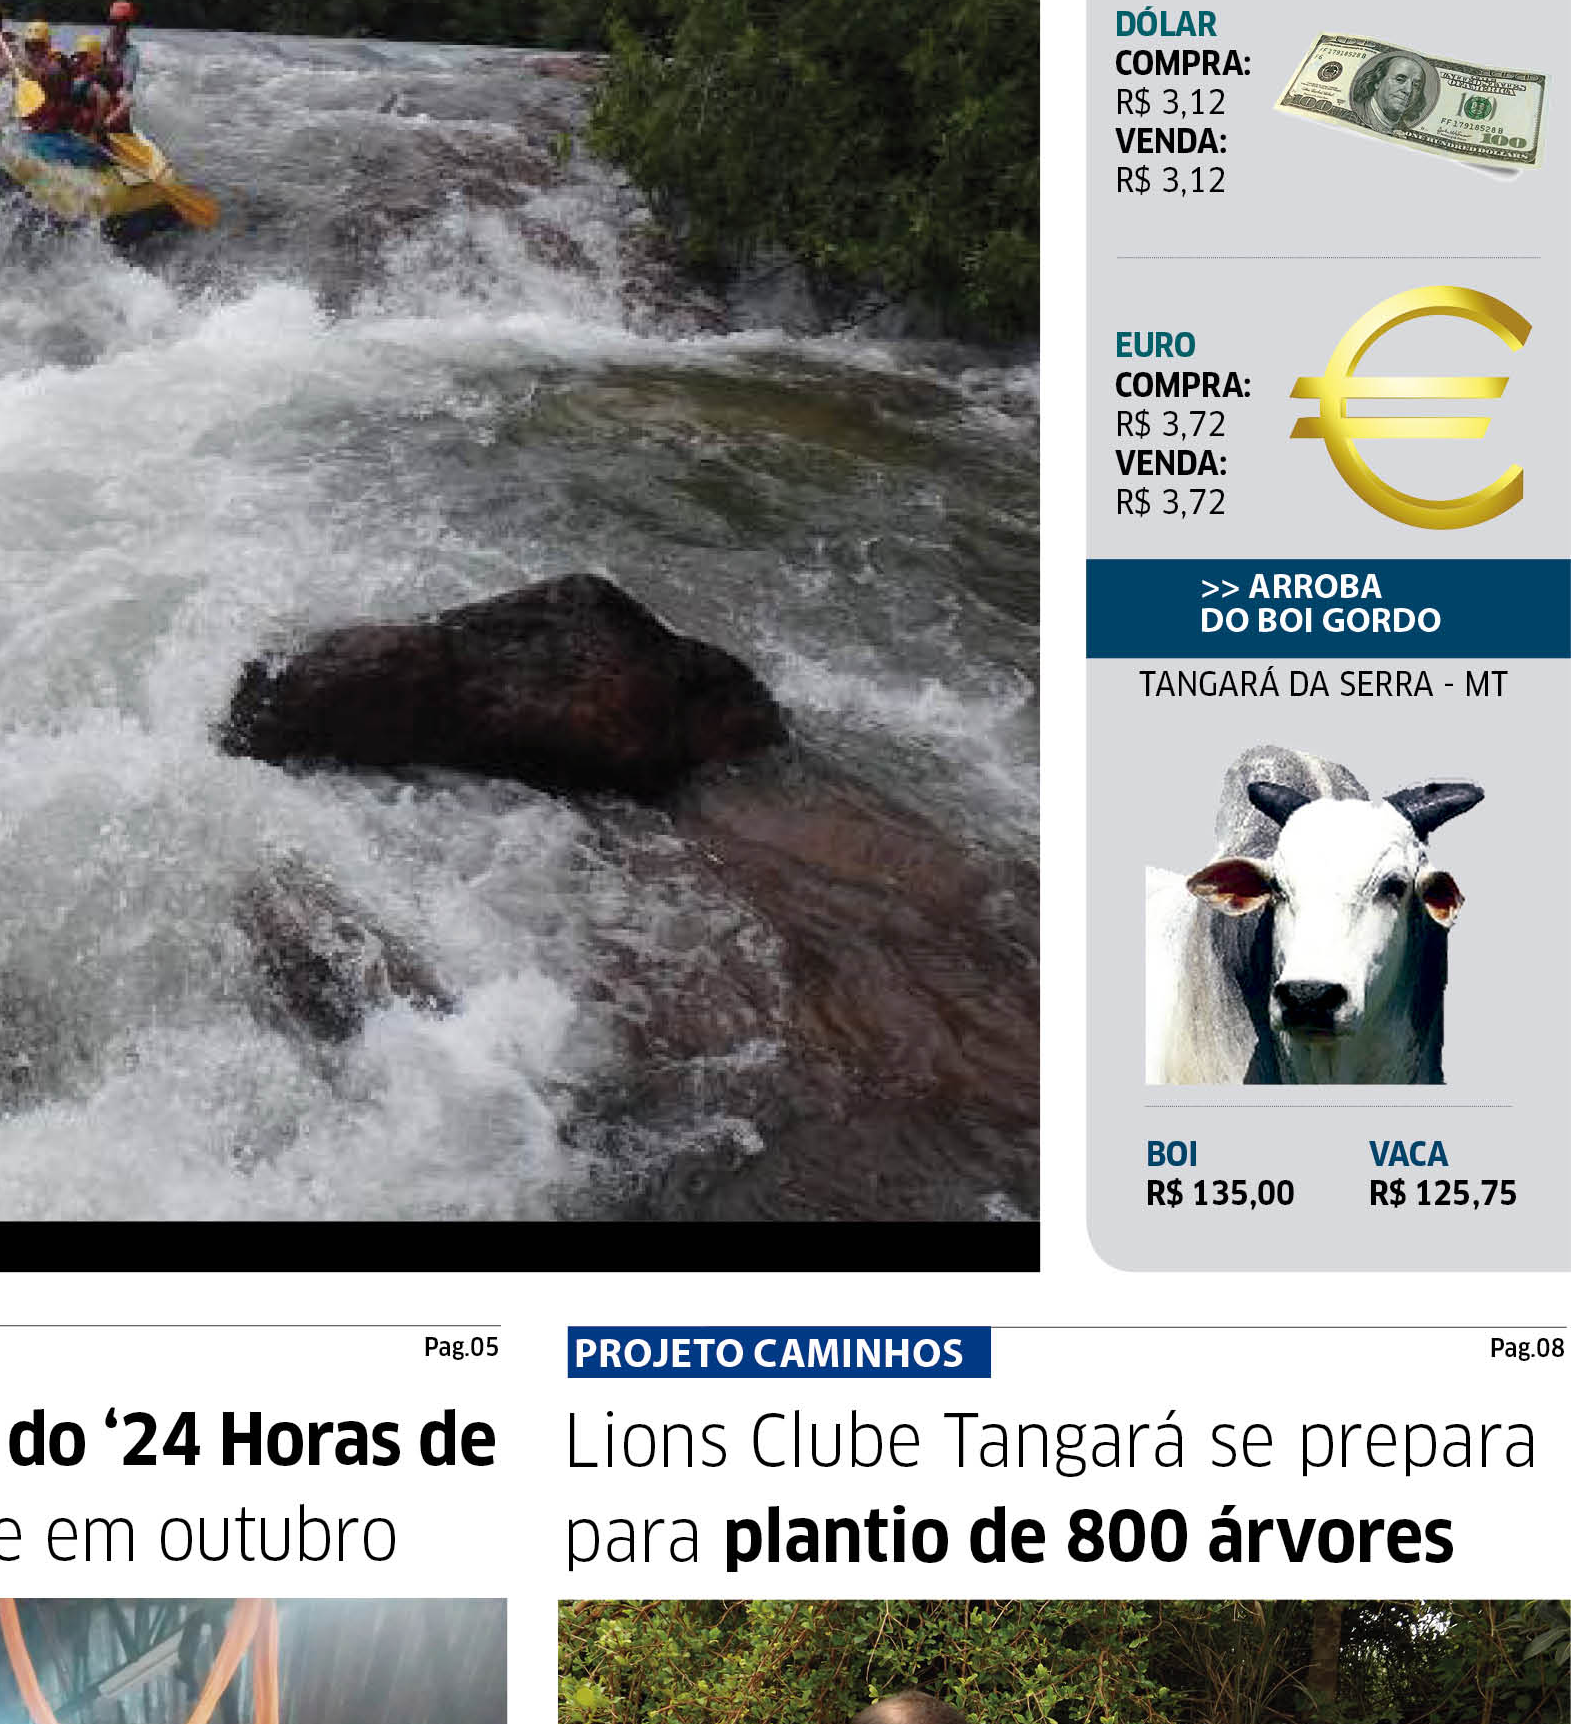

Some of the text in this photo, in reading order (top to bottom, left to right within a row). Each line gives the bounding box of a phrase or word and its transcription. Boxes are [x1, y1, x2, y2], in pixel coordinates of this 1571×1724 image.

[1116, 5, 1218, 37] DÓLAR
[1117, 86, 1225, 120] R$ 3,12
[1116, 330, 1196, 358] EURO
[1248, 573, 1383, 599] ARROBA
[1201, 607, 1442, 633] DO BOI GORDO
[1147, 1140, 1197, 1167] BOI
[1147, 1177, 1295, 1211] R$ 135,00
[424, 1336, 499, 1361] Pag.05
[575, 1338, 964, 1368] PROJETO CAMINHOS
[1490, 1337, 1565, 1362] Pag.08
[47, 1517, 134, 1562] em
[160, 1503, 396, 1562] outubro
[568, 1504, 1454, 1573] para plantio de 800 árvores
